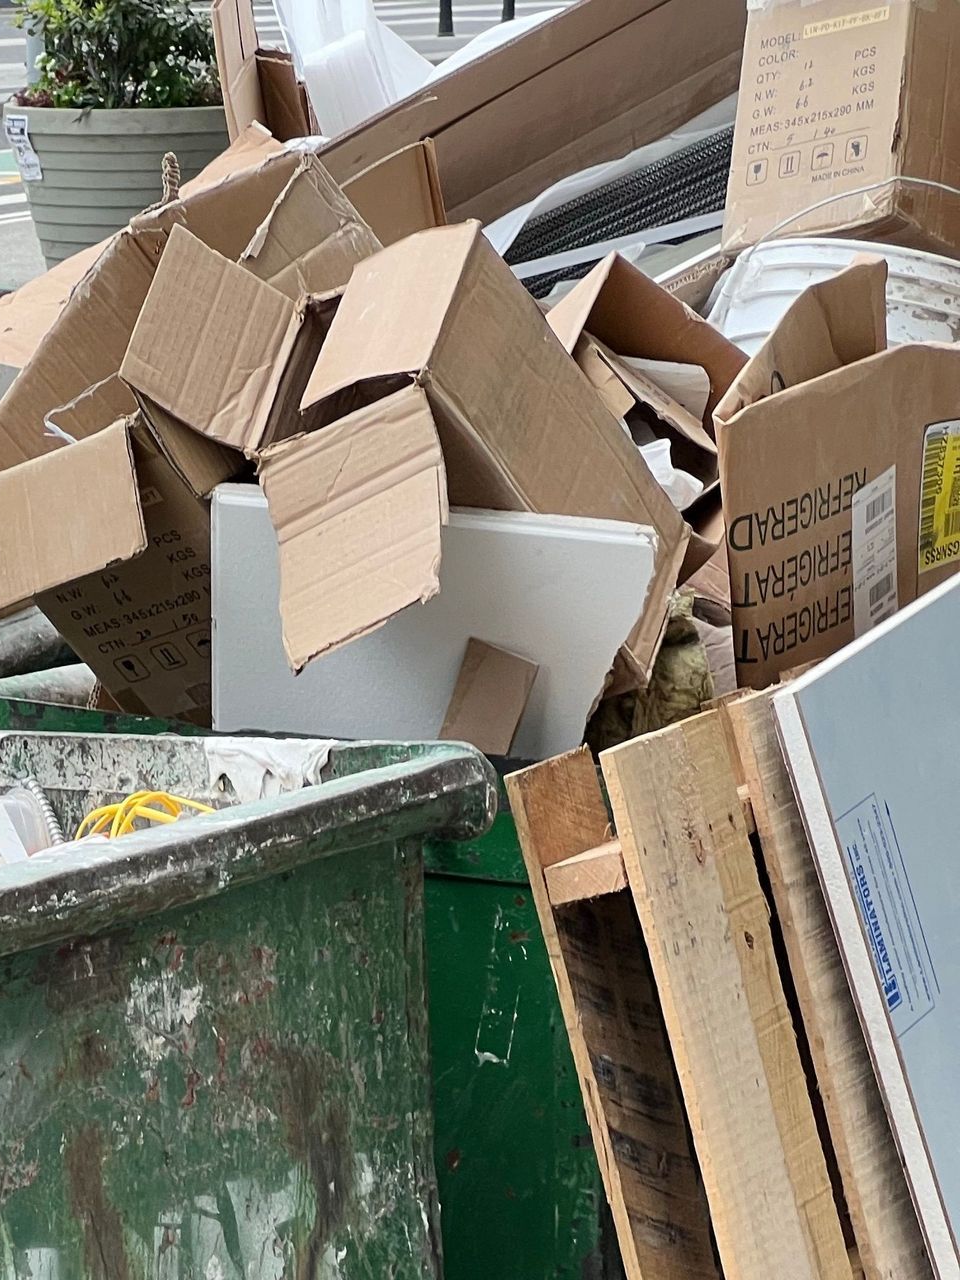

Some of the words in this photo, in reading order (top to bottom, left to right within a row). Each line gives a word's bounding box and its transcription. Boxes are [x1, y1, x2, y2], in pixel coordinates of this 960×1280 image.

[760, 32, 801, 50] MODEL:
[756, 71, 781, 84] QTY:
[854, 46, 877, 60] PCS
[758, 49, 799, 67] COLOR:
[852, 64, 876, 78] KGS
[852, 81, 875, 96] KGS
[856, 99, 874, 112] MM
[811, 173, 832, 184] MADE
[842, 166, 865, 178] CHINA
[153, 530, 182, 548] PCS
[167, 547, 197, 565] KGS
[182, 563, 211, 582] KGS
[733, 528, 853, 609] ÉFRIGÉRAT
[736, 583, 854, 664] EFRIGERAT
[856, 865, 893, 976] LAMINATORS
